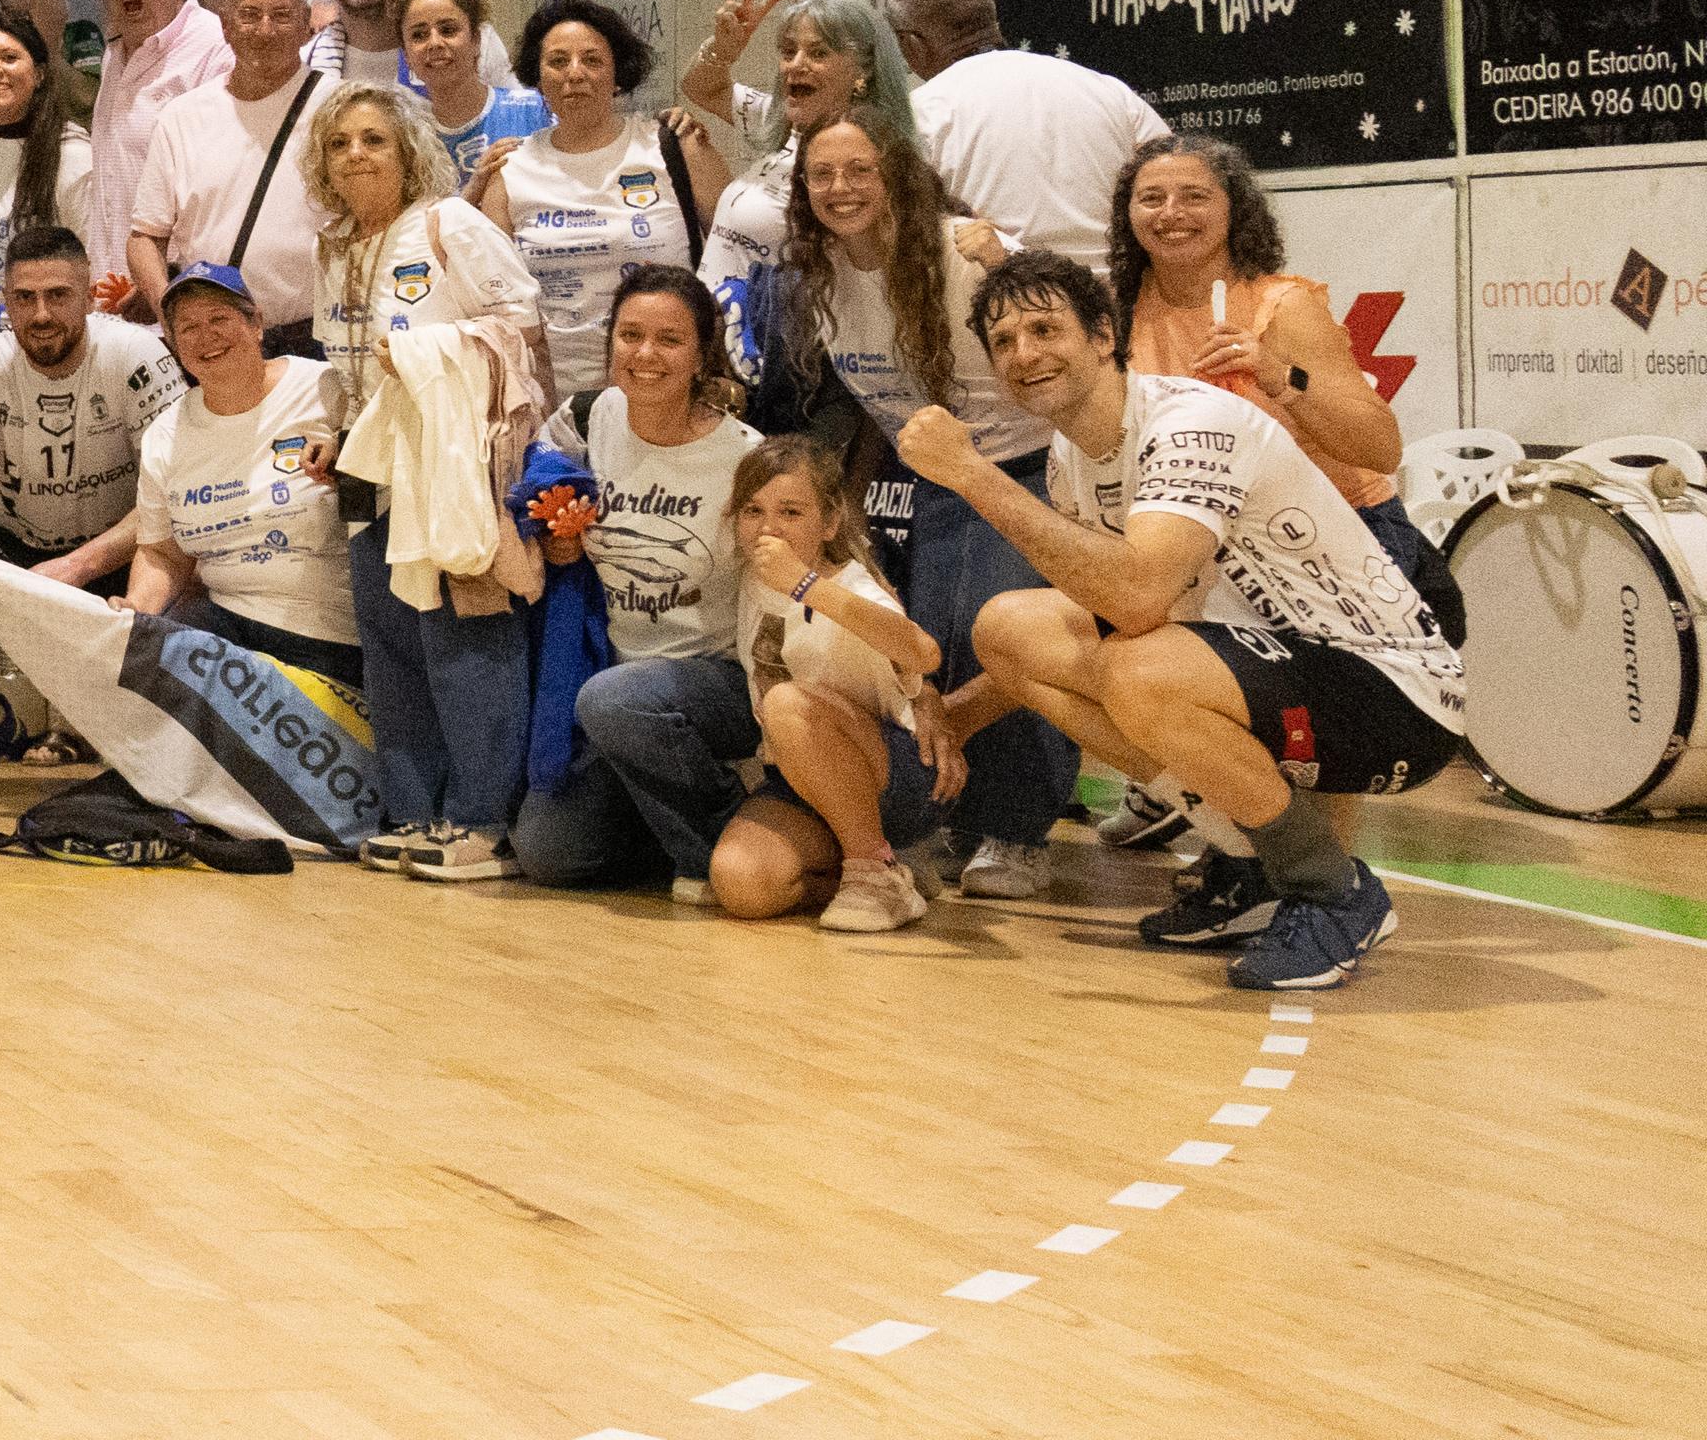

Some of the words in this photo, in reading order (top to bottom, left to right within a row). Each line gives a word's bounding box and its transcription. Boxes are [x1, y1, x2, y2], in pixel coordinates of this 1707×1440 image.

[1284, 70, 1365, 93] Pontevedra
[1481, 53, 1561, 85] Baixada
[1567, 60, 1581, 78] a
[1588, 45, 1678, 76] Estación,
[1493, 92, 1586, 123] CEDEIRA
[1590, 87, 1634, 117] 986
[1640, 82, 1683, 112] 400
[535, 210, 565, 229] MG
[1482, 268, 1606, 309] amador
[1487, 347, 1555, 377] imprenta
[1575, 347, 1623, 374] dixital
[1646, 349, 1707, 375] deseño
[40, 440, 77, 479] 17
[28, 461, 136, 498] LINOCASQUERO
[183, 484, 213, 508] MG
[213, 479, 244, 493] Mundo
[597, 481, 704, 524] Sardines
[1620, 584, 1643, 724] Concerto
